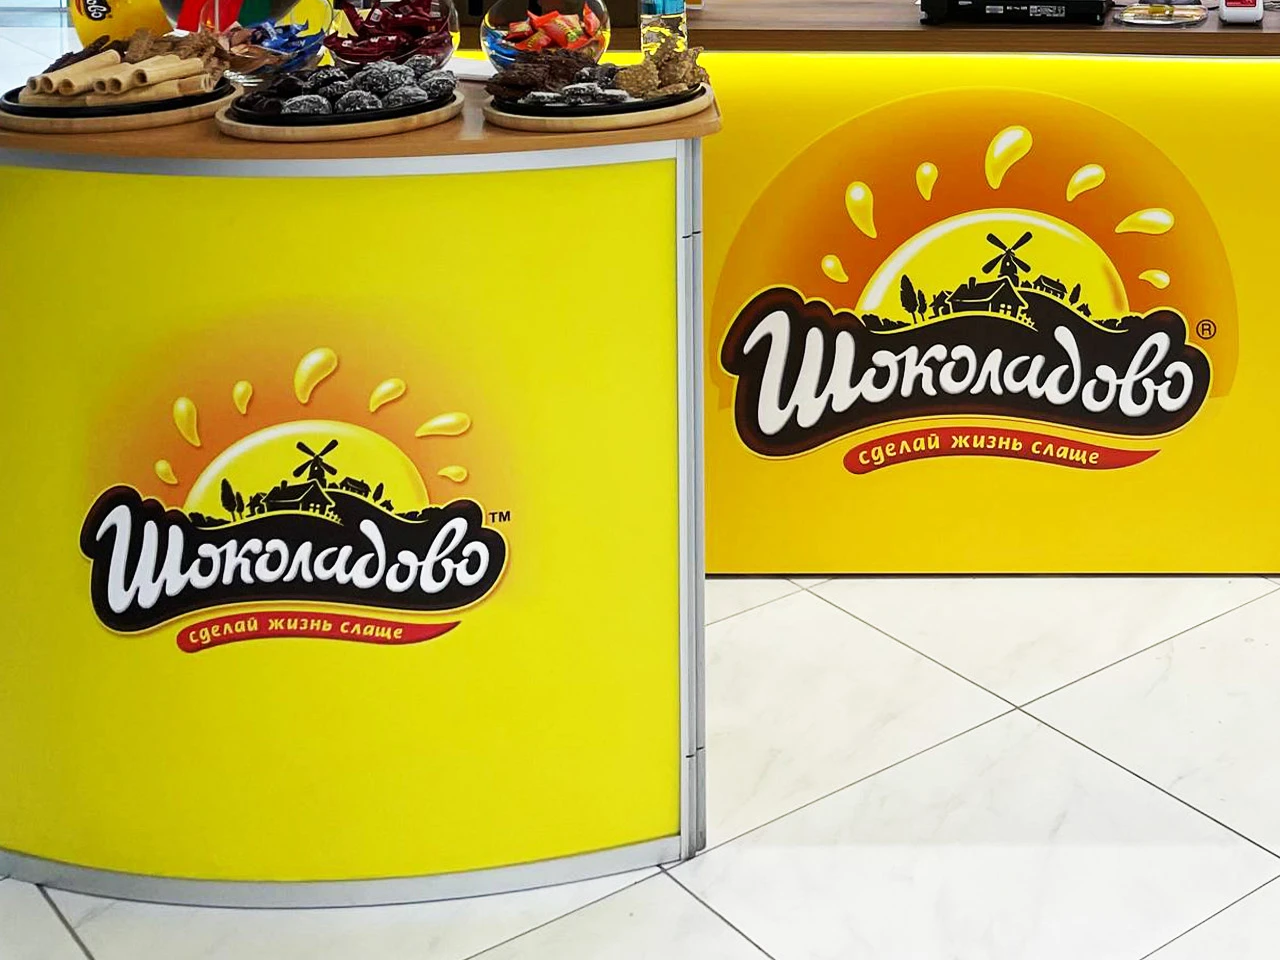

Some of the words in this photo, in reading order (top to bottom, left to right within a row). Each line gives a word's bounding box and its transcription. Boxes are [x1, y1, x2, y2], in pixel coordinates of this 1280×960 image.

[742, 309, 1195, 436] Шоколадово
[857, 431, 942, 467] сделай
[950, 434, 1024, 454] жизнь
[1031, 438, 1101, 467] слаще
[95, 504, 490, 614] Шоколадово
[188, 616, 259, 646] сделай
[267, 617, 333, 634] жизнь
[339, 620, 404, 642] слаще
